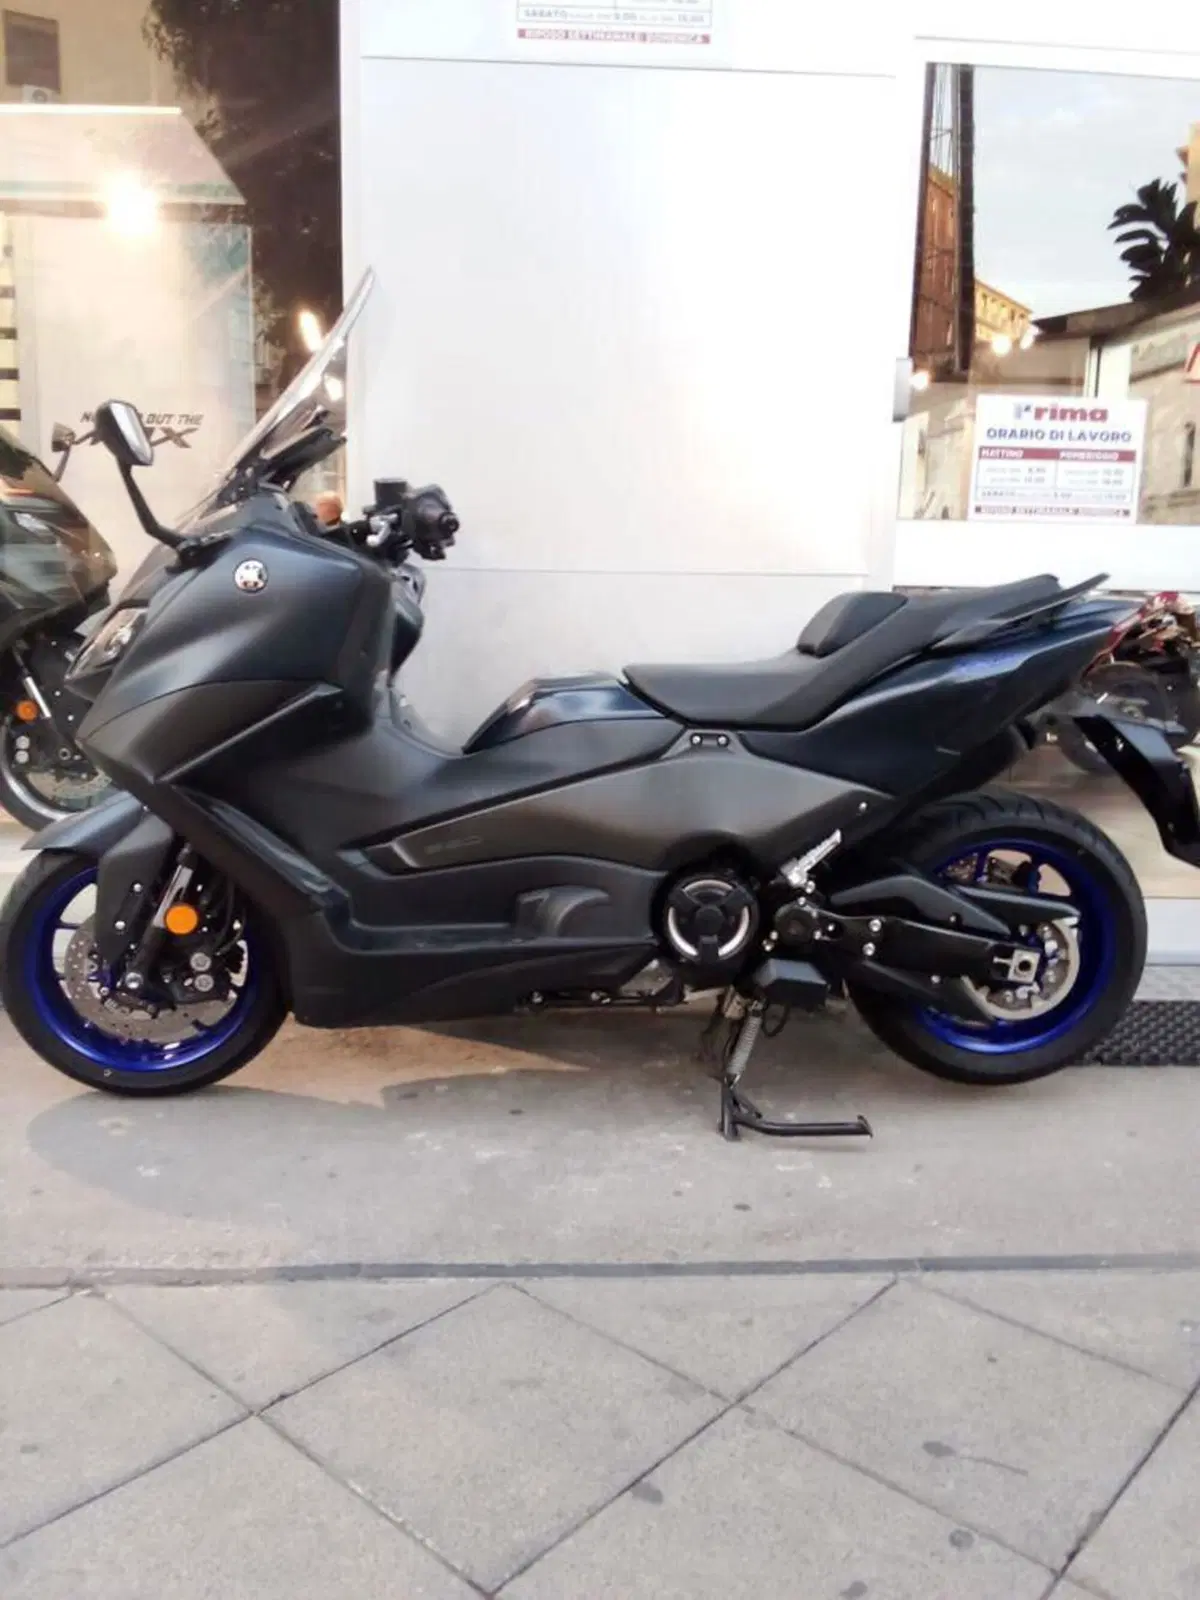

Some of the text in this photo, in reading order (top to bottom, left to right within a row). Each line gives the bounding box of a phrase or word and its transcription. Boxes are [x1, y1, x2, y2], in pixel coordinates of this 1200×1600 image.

[145, 413, 174, 425] BUT
[176, 413, 205, 426] THE
[986, 427, 1132, 444] ORARIO DI LAVORO
